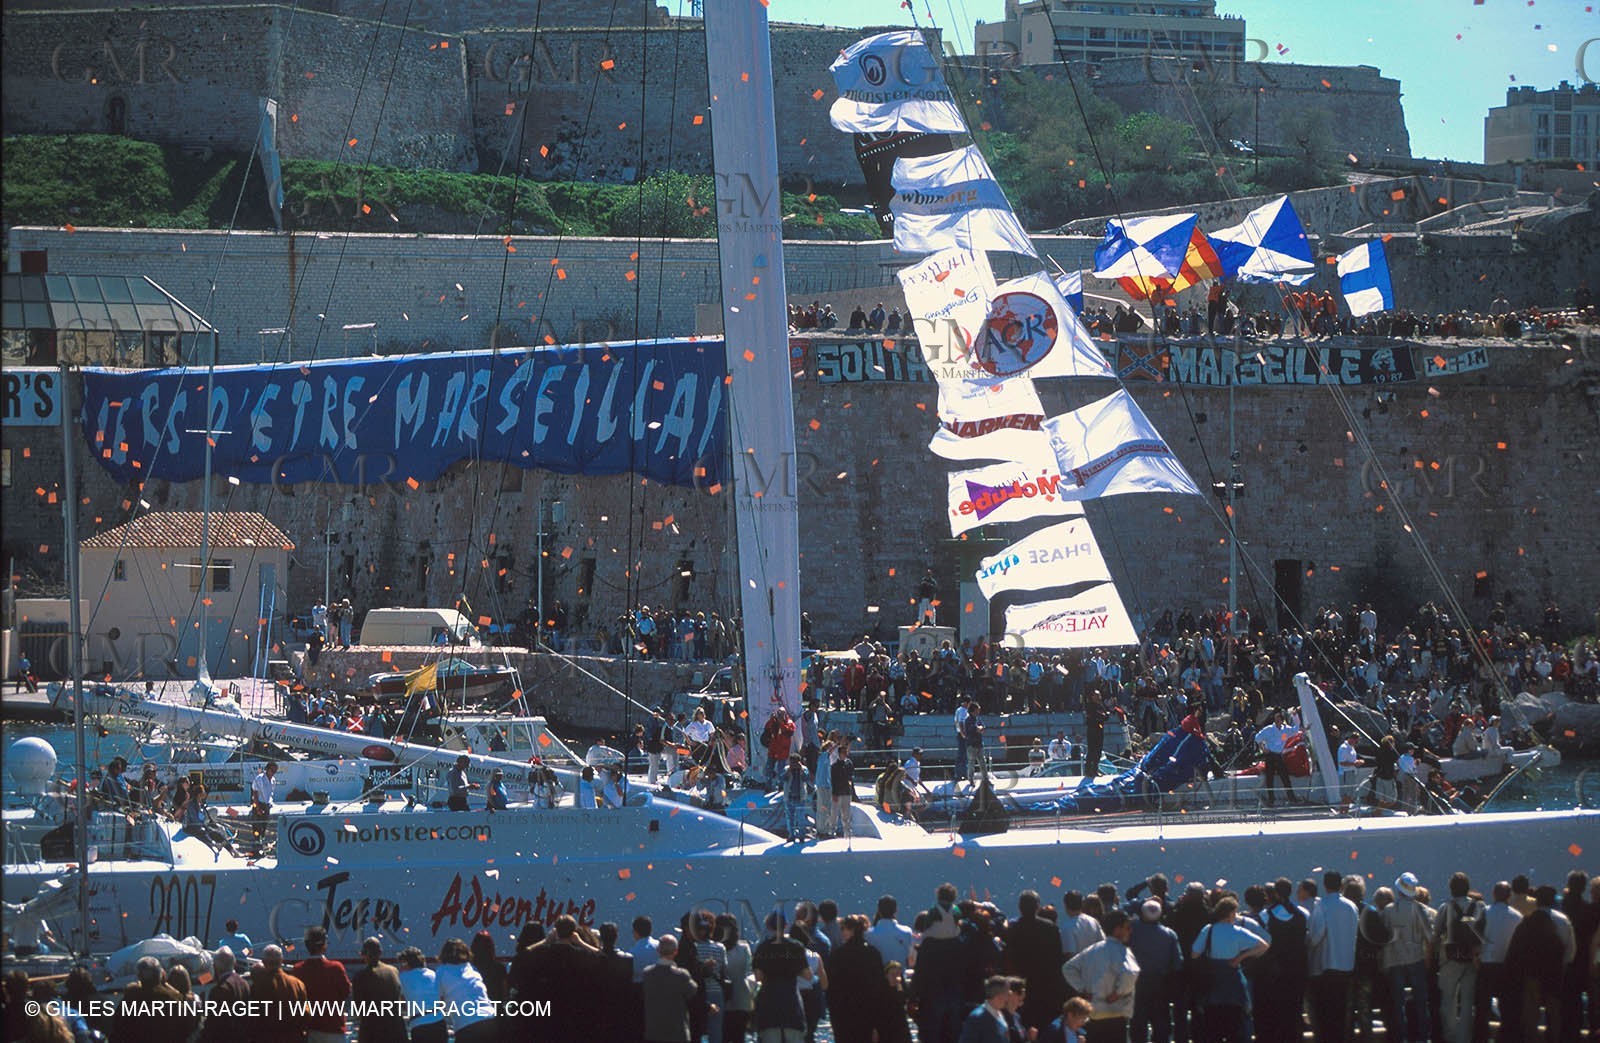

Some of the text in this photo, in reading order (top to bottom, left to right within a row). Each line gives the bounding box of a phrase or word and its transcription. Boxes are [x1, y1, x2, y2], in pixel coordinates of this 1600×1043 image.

[1169, 345, 1361, 385] MARSEILLE
[210, 374, 366, 453] D'ETRE
[336, 824, 492, 843] monster.com
[151, 874, 217, 948] 2007
[431, 872, 597, 937] Adventure
